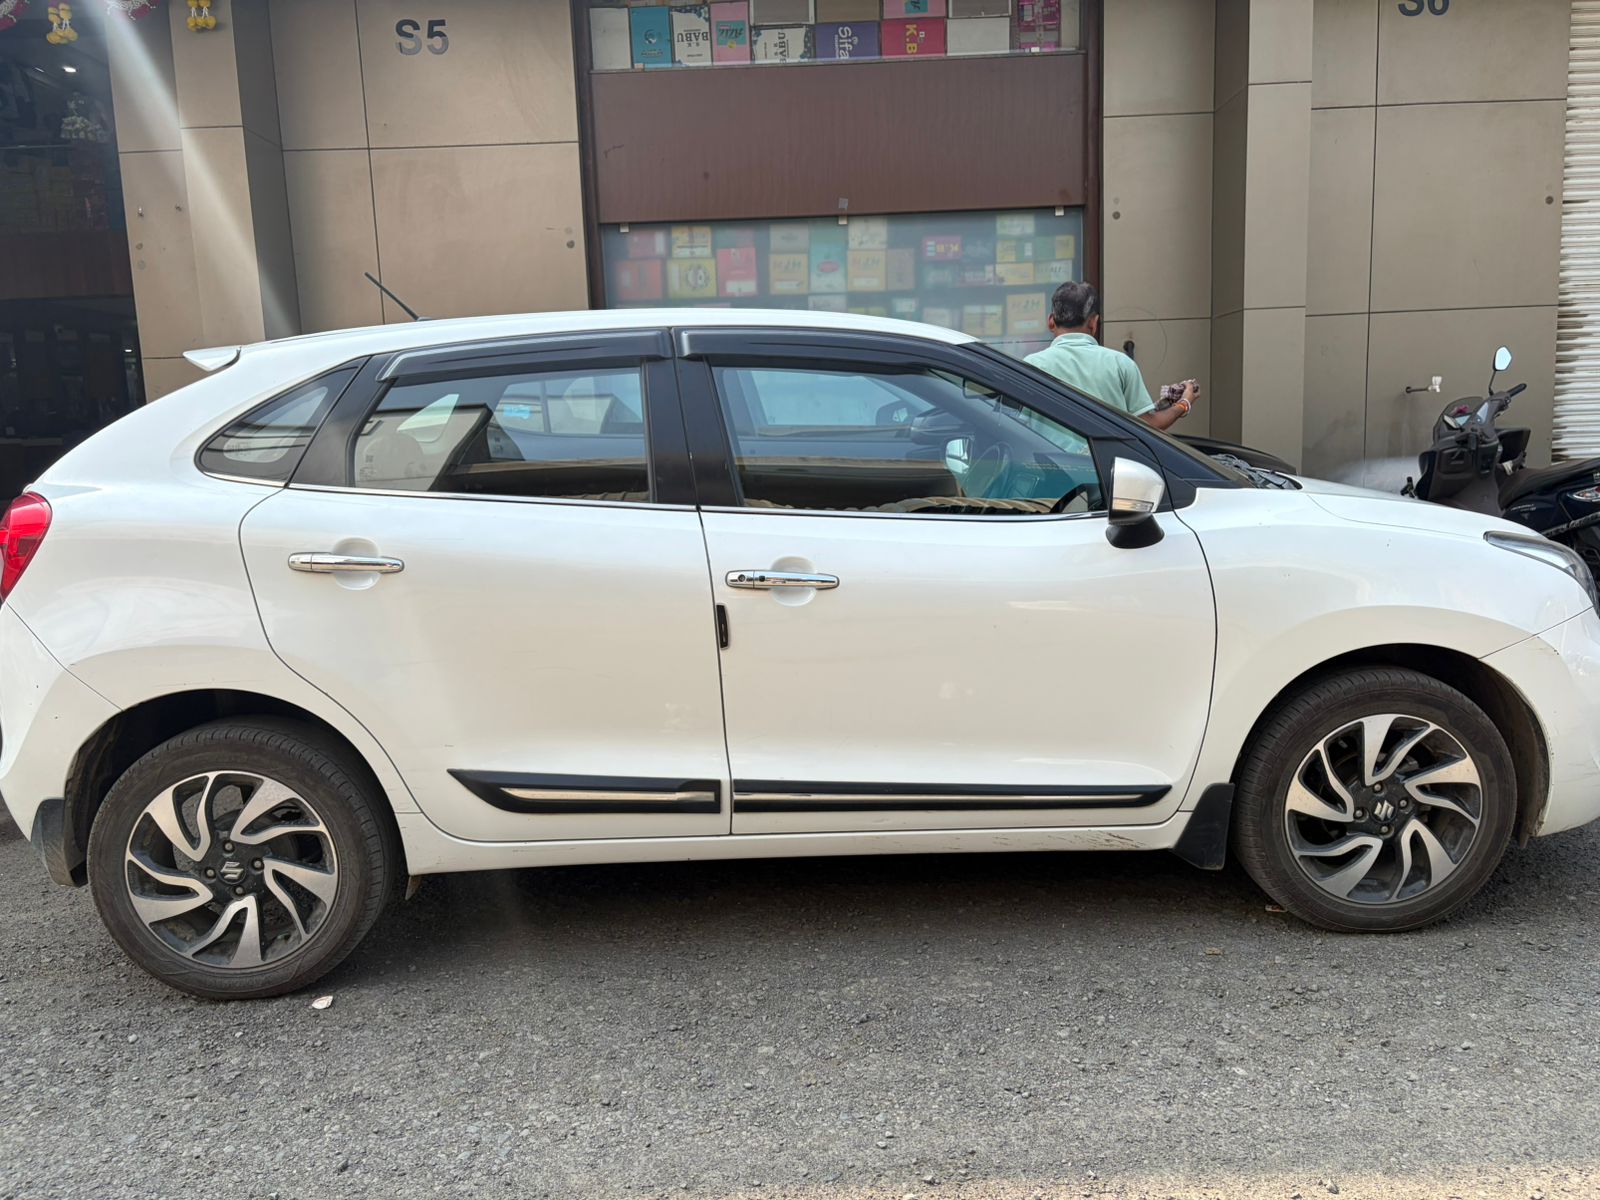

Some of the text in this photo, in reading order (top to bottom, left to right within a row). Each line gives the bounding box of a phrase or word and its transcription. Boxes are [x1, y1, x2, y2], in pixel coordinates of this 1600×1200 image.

[395, 18, 449, 56] S5
[677, 32, 709, 42] BABU
[838, 26, 853, 59] Sifa
